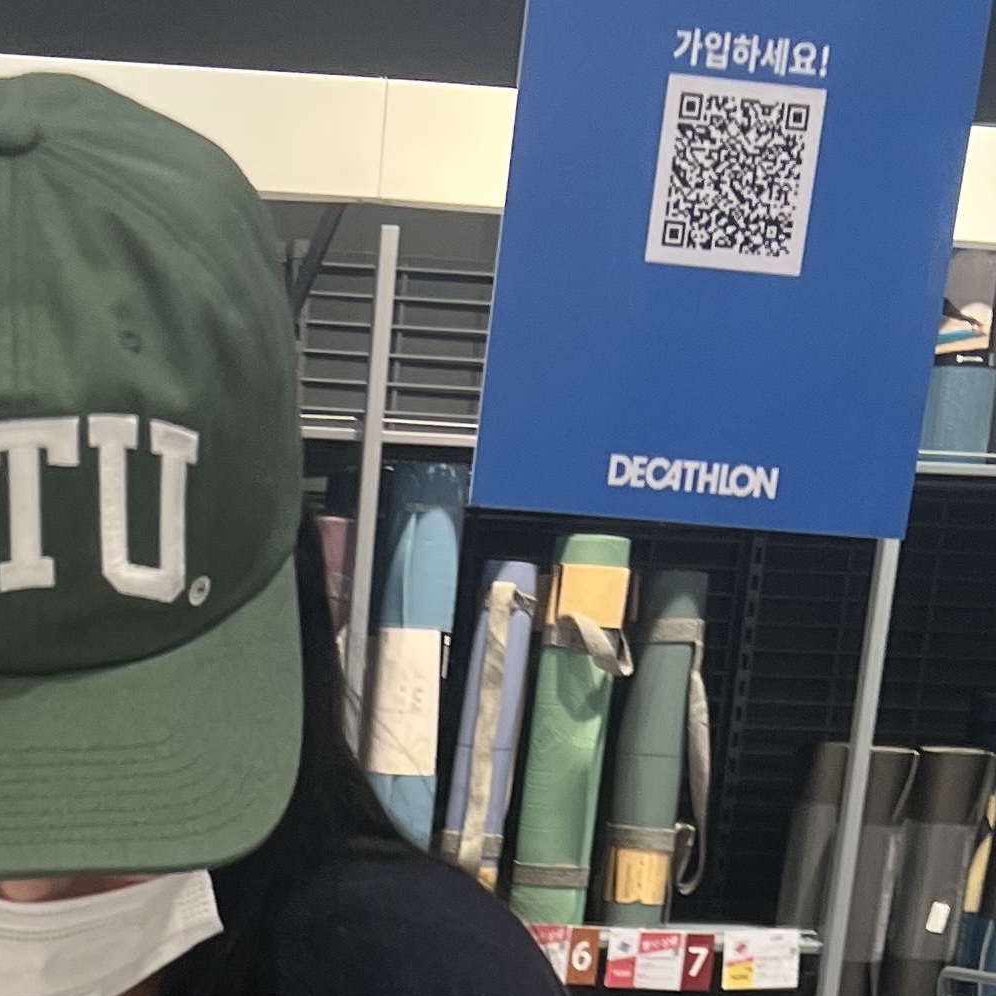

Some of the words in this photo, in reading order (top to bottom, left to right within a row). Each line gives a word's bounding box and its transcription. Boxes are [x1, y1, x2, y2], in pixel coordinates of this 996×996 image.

[673, 27, 831, 78] 가입하세요!
[607, 453, 780, 500] DECATHLON
[571, 940, 593, 972] 6
[687, 945, 710, 978] 7
